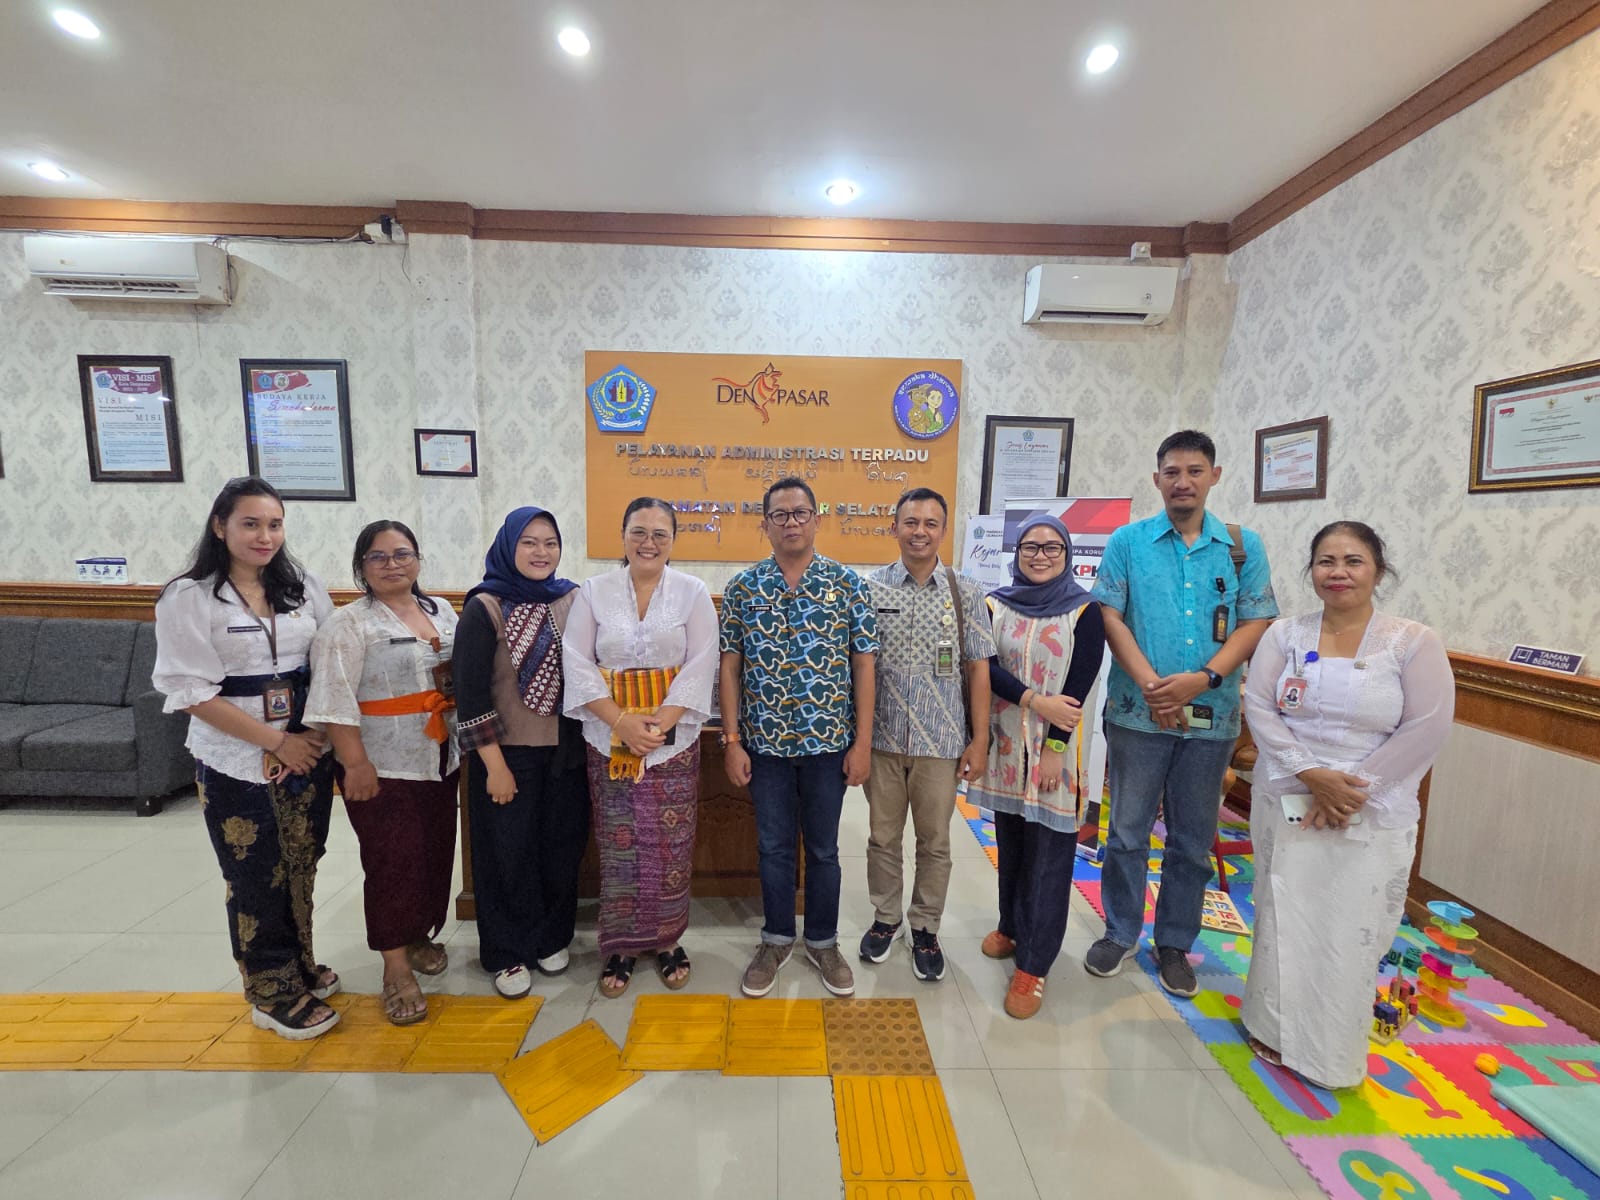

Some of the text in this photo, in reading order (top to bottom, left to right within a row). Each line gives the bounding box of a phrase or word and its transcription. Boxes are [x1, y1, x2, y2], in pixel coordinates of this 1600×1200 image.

[111, 373, 130, 382] VISI
[136, 374, 156, 382] MISI
[616, 442, 929, 463] PELAYANAN ADMINISTRASI TERPADU
[836, 502, 897, 516] SELATA
[1532, 657, 1570, 670] BERMAIN
[1539, 651, 1570, 663] TAMAN
